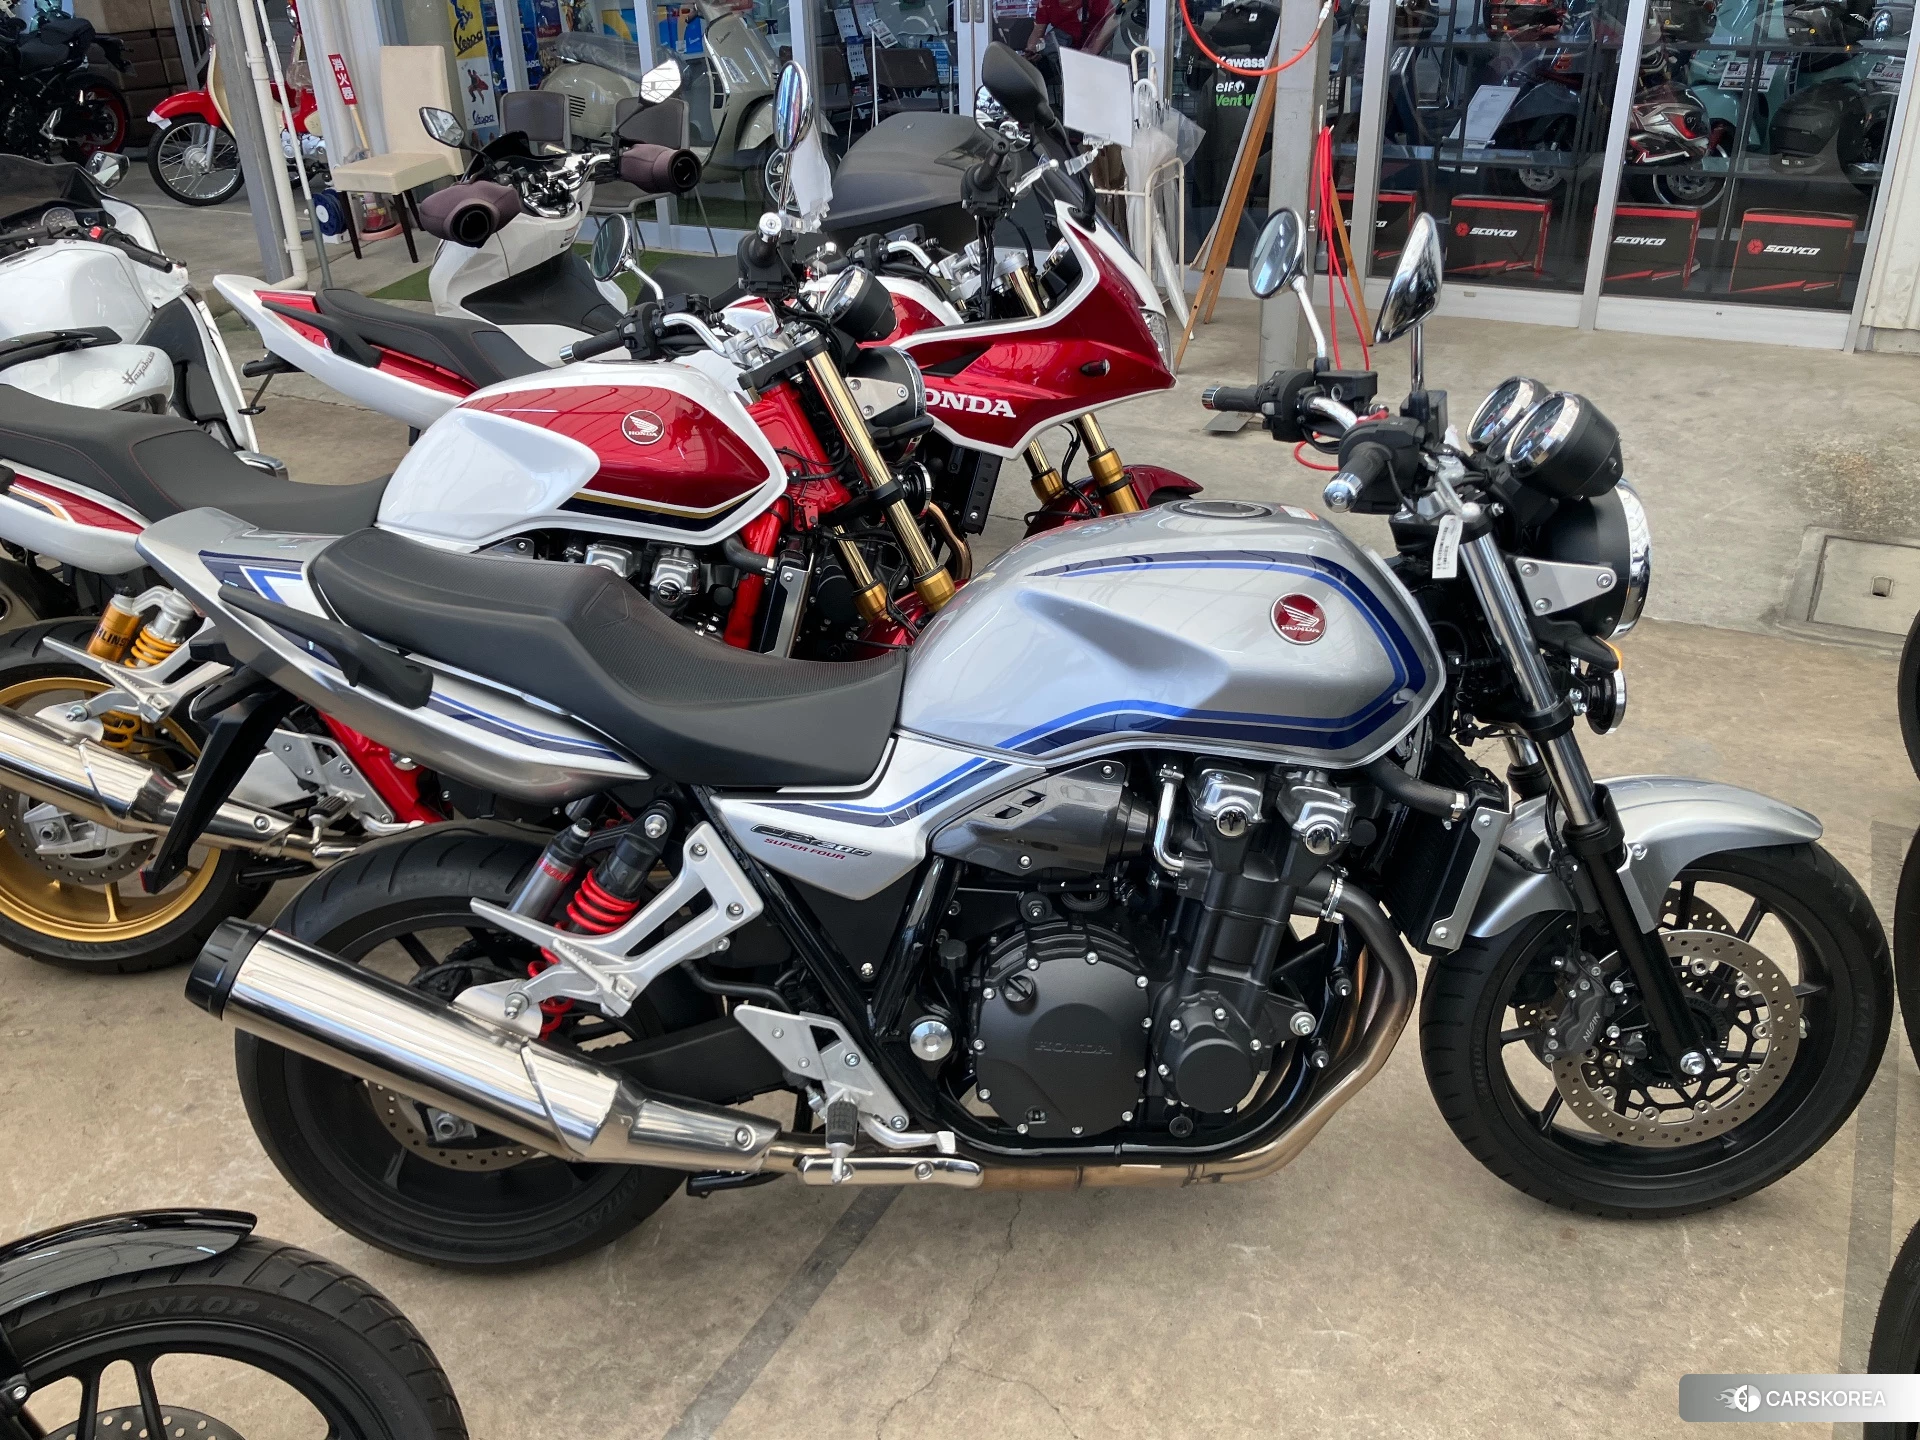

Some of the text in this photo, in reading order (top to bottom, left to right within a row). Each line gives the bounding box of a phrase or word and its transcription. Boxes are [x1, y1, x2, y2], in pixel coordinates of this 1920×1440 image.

[454, 20, 484, 57] Vespa
[1216, 56, 1267, 69] Kawasa
[1215, 94, 1243, 106] Vent
[473, 109, 495, 126] Vespa
[1469, 227, 1518, 238] SCOYCO
[1613, 235, 1667, 246] SCOYCO
[1763, 244, 1821, 256] SCOYCO
[925, 388, 1017, 418] ONDA
[1280, 624, 1320, 633] HONDA
[764, 837, 846, 860] SUPER FOUR
[1034, 1040, 1113, 1055] HONDA
[77, 1294, 261, 1332] DUNLOP
